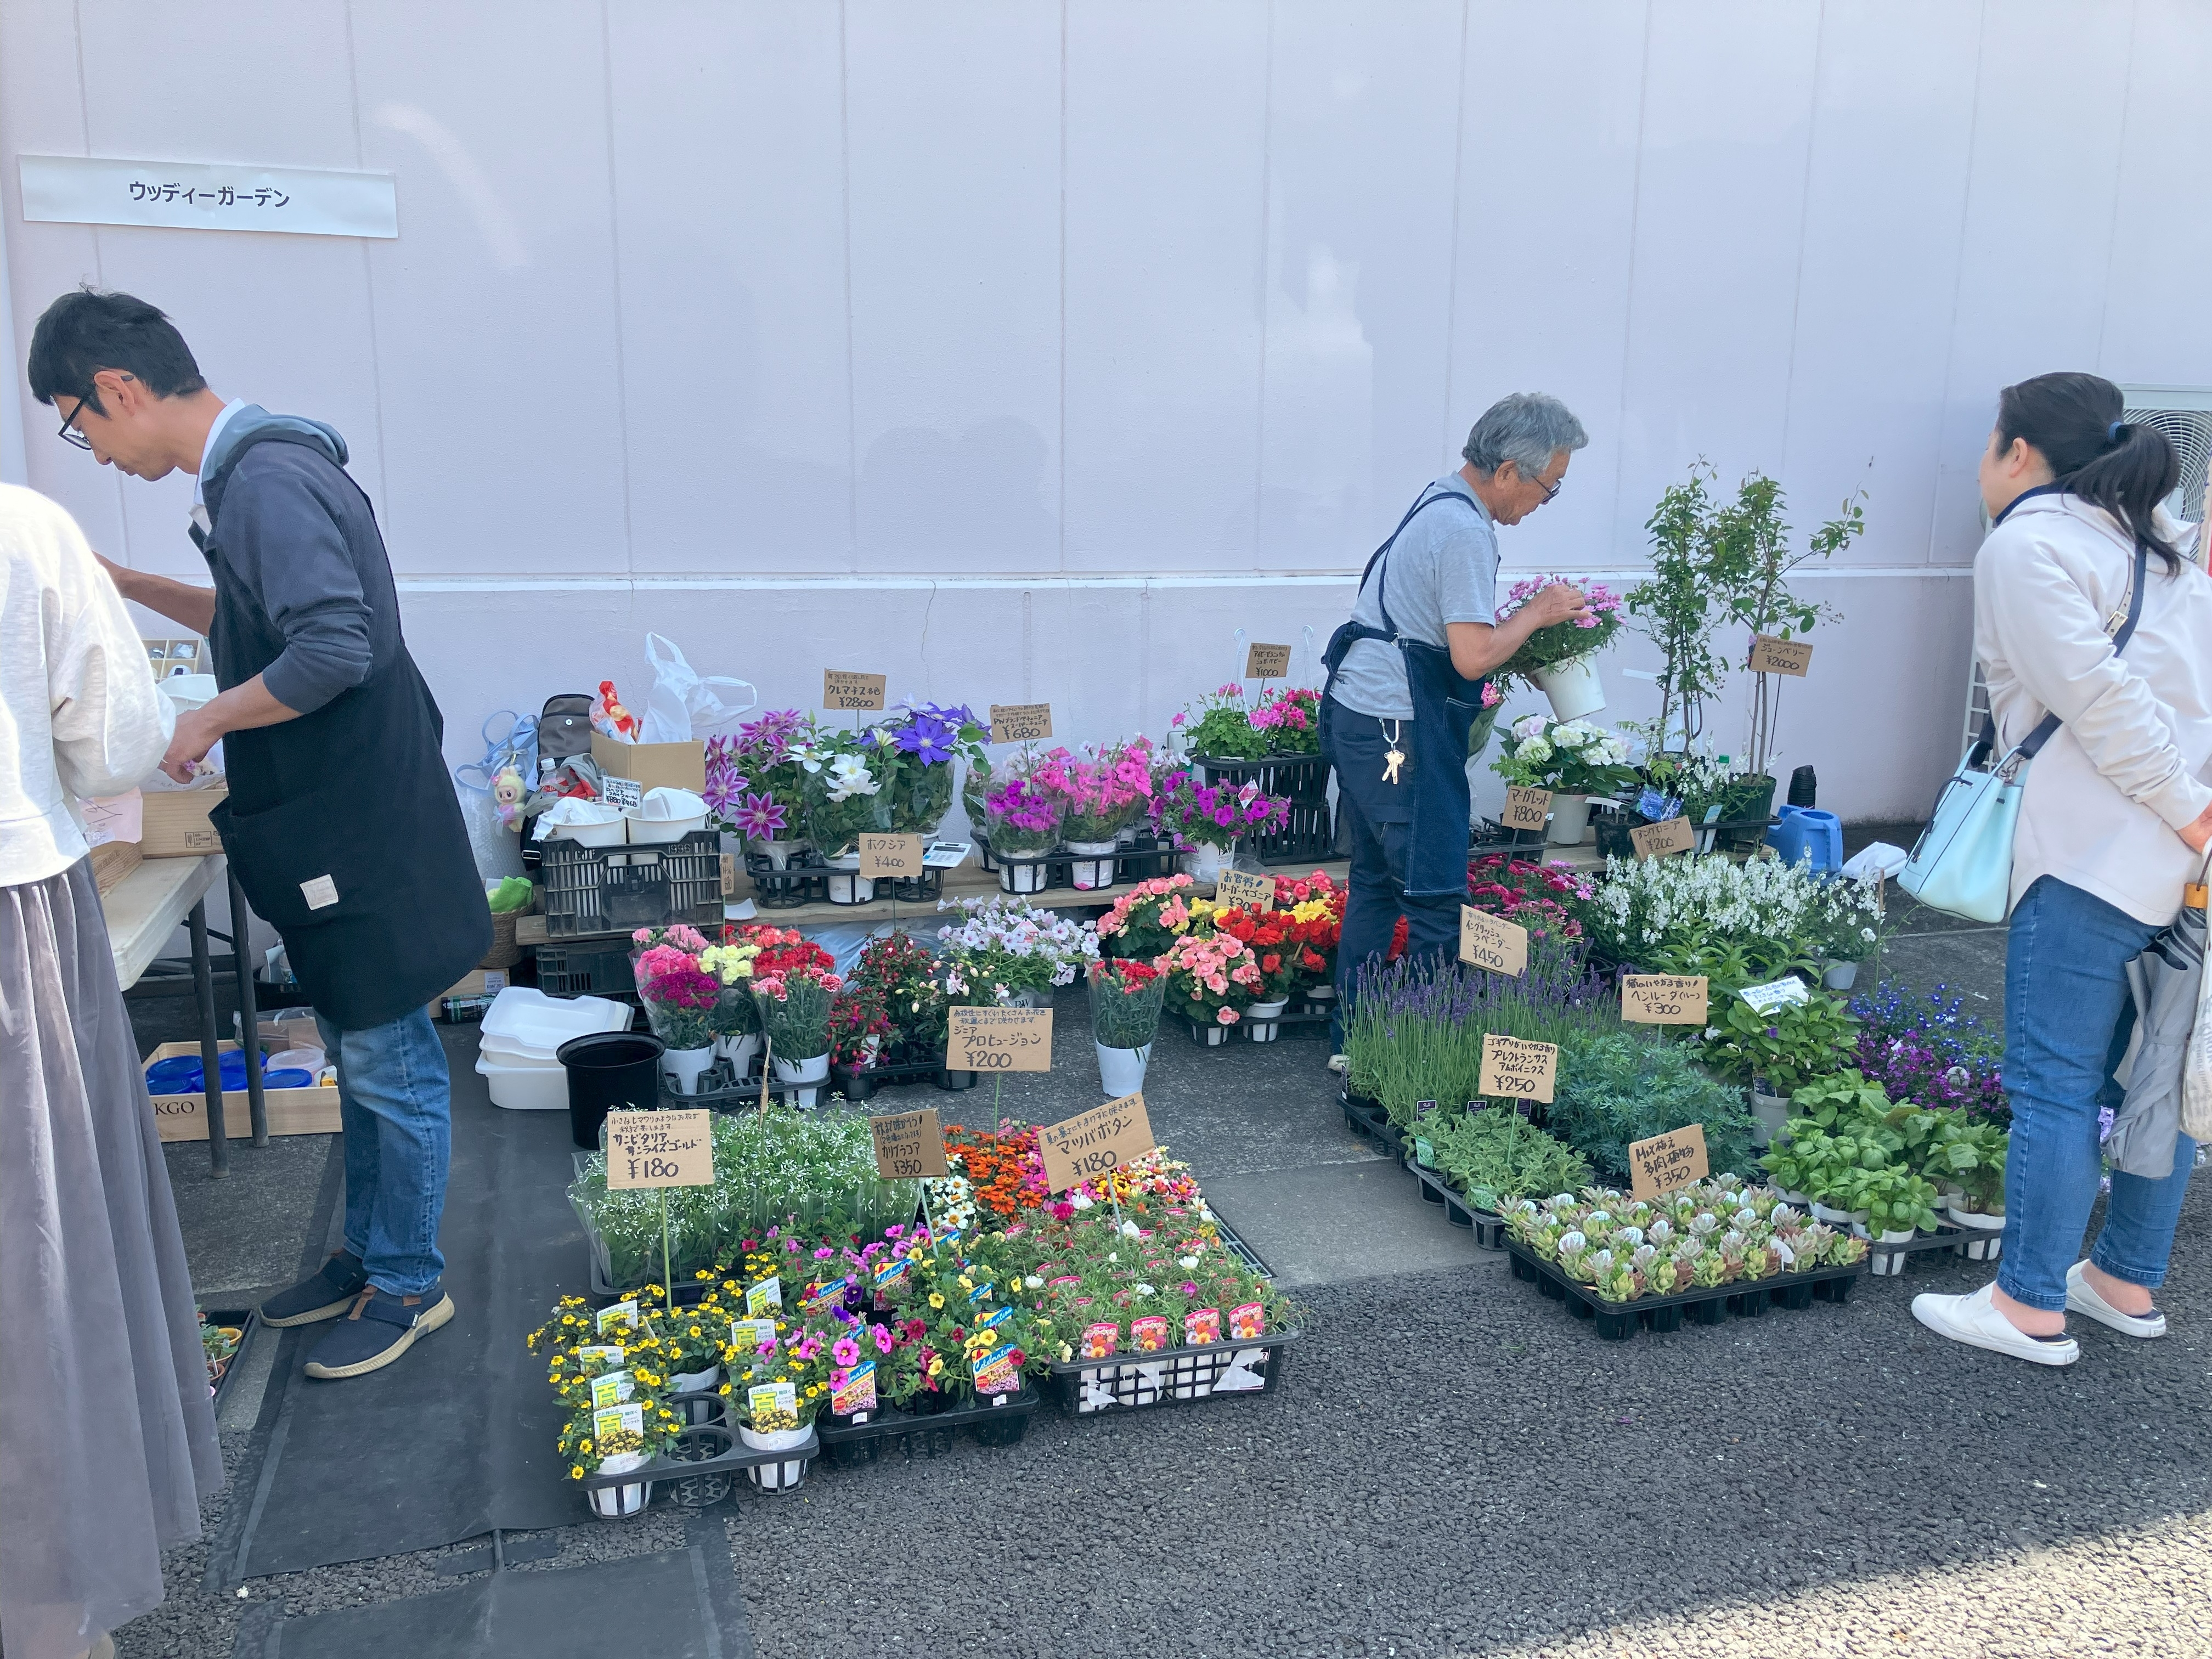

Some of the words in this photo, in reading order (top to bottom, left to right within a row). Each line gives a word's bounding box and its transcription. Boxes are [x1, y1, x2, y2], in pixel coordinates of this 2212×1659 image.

[129, 181, 290, 207] ウッディーガーデン
[1766, 655, 1799, 669] ¥2000
[1256, 667, 1279, 676] ¥1000
[839, 696, 874, 707] ¥2800
[1002, 725, 1041, 740] ¥680
[1511, 788, 1549, 805] マーガレット
[1513, 805, 1542, 822] ¥800
[1646, 837, 1674, 851] ¥200
[875, 856, 905, 867] ¥400
[1221, 883, 1271, 901] リーガーベゴニア
[1228, 896, 1254, 913] ¥30
[1466, 919, 1500, 938] イングリッシュ
[1474, 933, 1512, 950] ラベンダー
[1472, 944, 1503, 967] ¥450
[1644, 1002, 1681, 1014] ¥300
[953, 1025, 977, 1035] ジニア
[962, 1032, 1041, 1048] プロヒュージョン
[964, 1050, 1013, 1068] ¥200
[1491, 1050, 1548, 1064] プレクトランサス
[1499, 1062, 1544, 1075] アムボイニクス
[1493, 1075, 1536, 1092] ¥250
[613, 1133, 667, 1146] サンビタリア
[1056, 1115, 1132, 1154] マツバボタン
[625, 1139, 702, 1156] サンライズゴールド
[628, 1158, 679, 1179] ¥180
[893, 1159, 922, 1175] ¥350
[1071, 1150, 1117, 1176] ¥180
[1644, 1145, 1694, 1177] 多肉植物
[1654, 1166, 1690, 1189] ¥350
[751, 1391, 777, 1412] 百
[596, 1413, 623, 1436] 百
